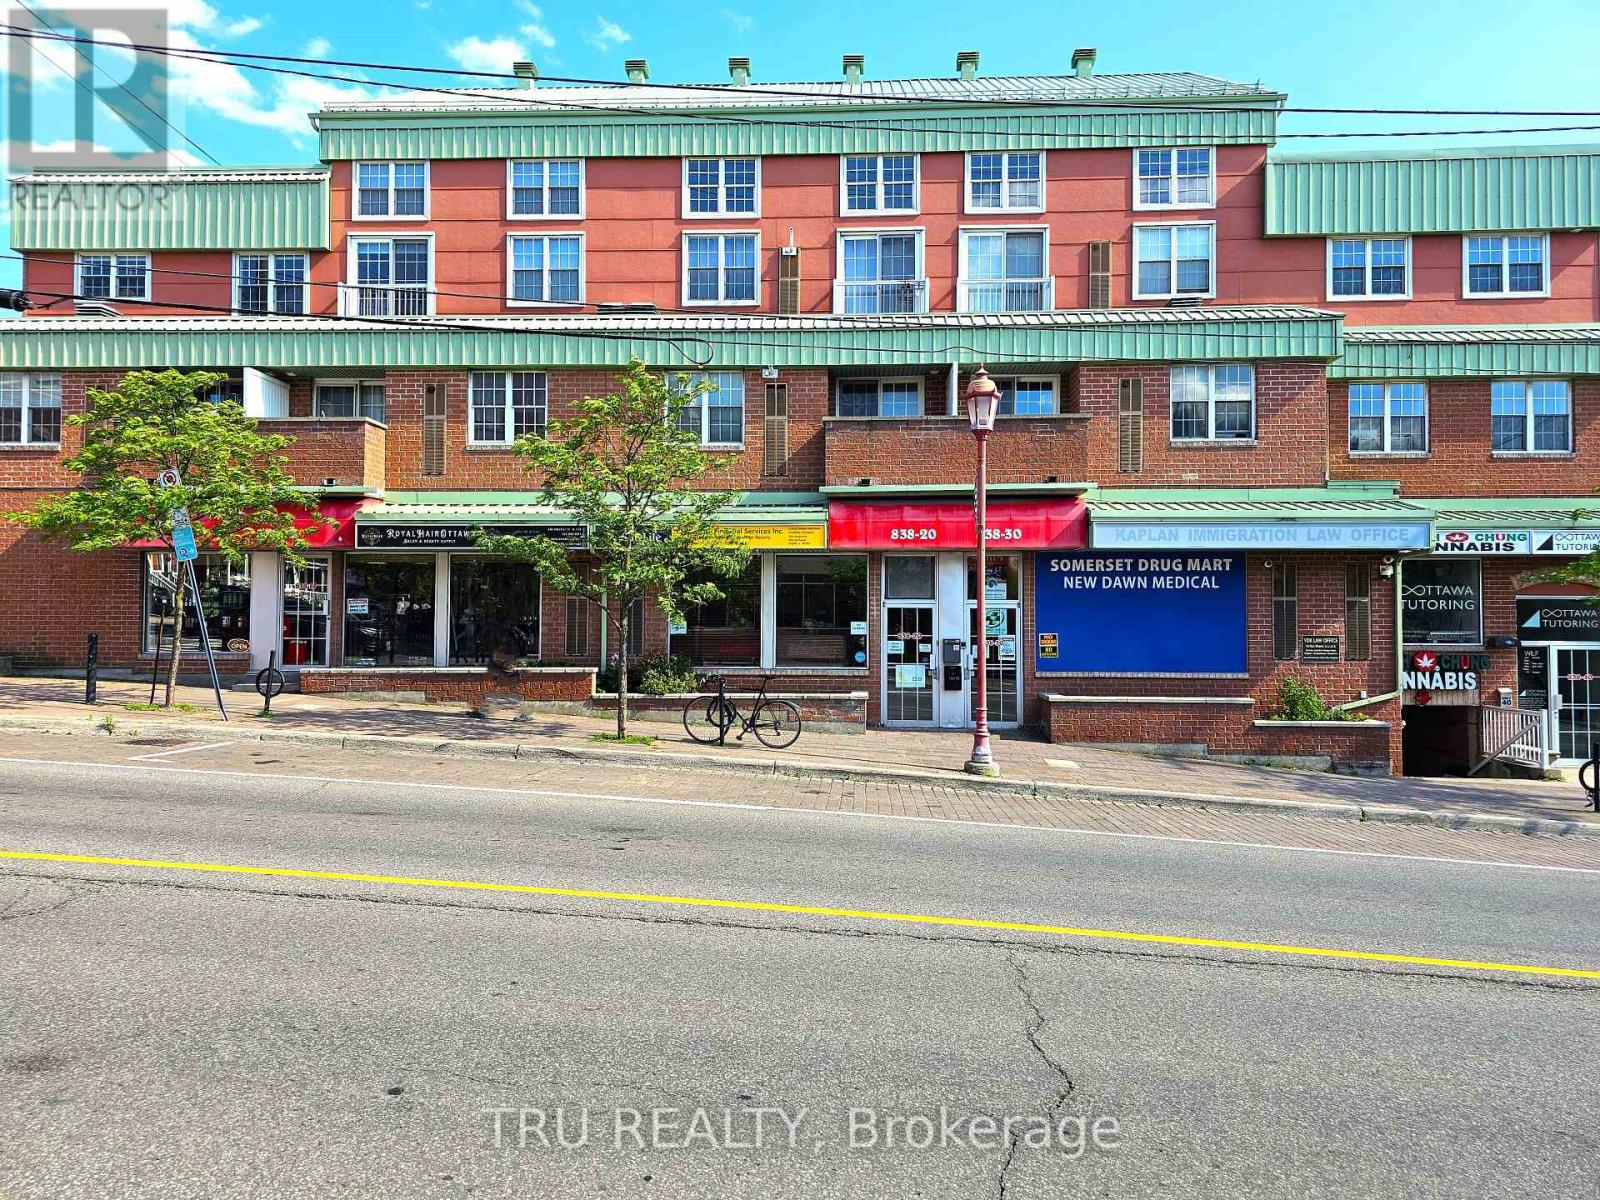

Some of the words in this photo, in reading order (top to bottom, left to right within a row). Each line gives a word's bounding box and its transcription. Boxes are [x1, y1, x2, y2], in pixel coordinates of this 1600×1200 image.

[440, 529, 473, 538] OTTAW
[744, 527, 771, 535] Services
[890, 528, 937, 540] 838-20
[984, 528, 1022, 540] 38-30
[1115, 528, 1178, 542] KAPLAN
[1188, 528, 1297, 542] IMMIGRATION
[1307, 528, 1342, 542] LAW
[1351, 528, 1409, 542] OFFICE
[1474, 533, 1528, 542] CHUNG
[1554, 533, 1600, 541] OTTAW
[1434, 542, 1515, 552] NNABIS
[1555, 543, 1599, 551] TUTORI
[1050, 558, 1133, 572] SOMERSET
[1138, 558, 1183, 572] DRUG
[1187, 558, 1232, 572] MART
[1063, 576, 1097, 589] NEW
[1102, 576, 1148, 589] DAWN
[1152, 575, 1219, 589] MEDICAL
[1401, 599, 1475, 610] TUTORING
[1542, 619, 1599, 629] TUTORING
[231, 642, 248, 650] OPEN
[1403, 671, 1477, 690] NNABIS
